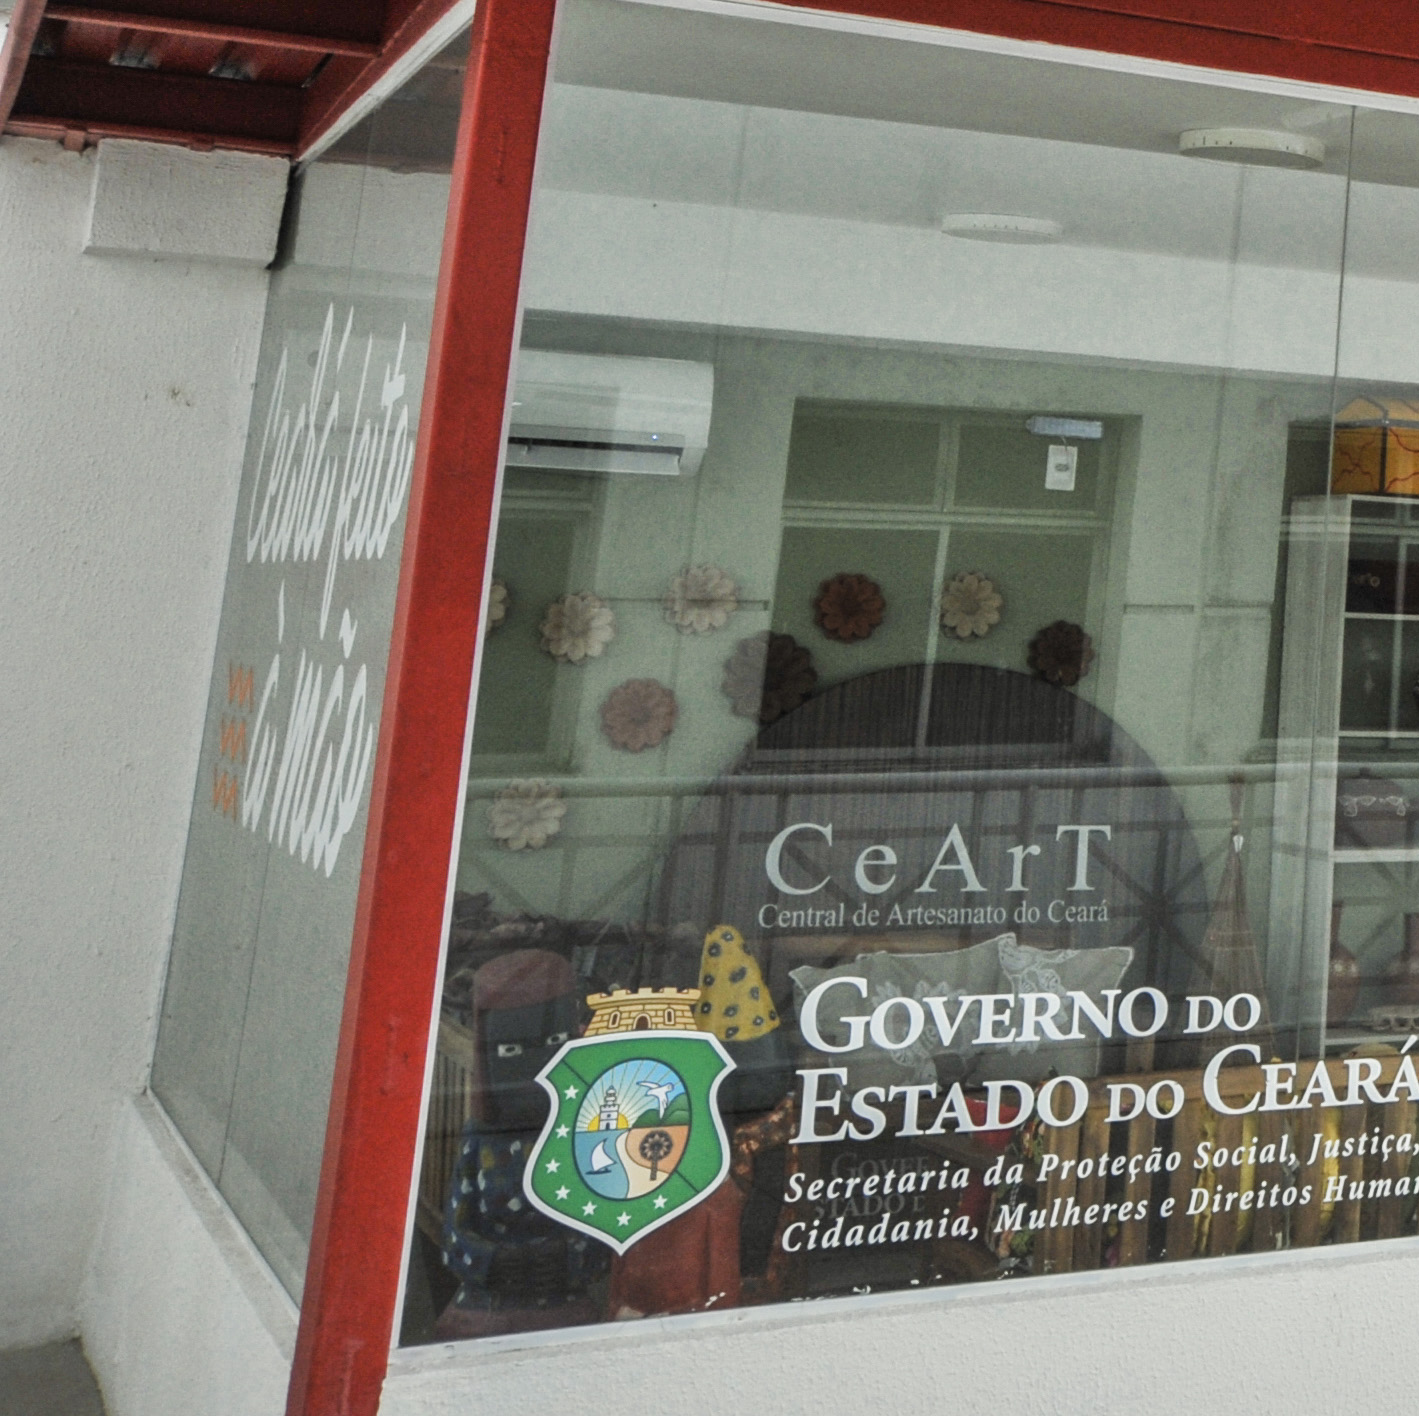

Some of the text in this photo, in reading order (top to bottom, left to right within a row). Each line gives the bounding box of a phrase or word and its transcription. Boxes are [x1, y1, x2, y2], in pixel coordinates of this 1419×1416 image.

[765, 823, 1112, 896] CeArT
[758, 899, 1110, 928] Central de Artesanato do Ceará
[800, 976, 1261, 1053] GOVERNO DO
[789, 1067, 1089, 1144] ESTADO
[1104, 1079, 1185, 1123] DO
[784, 1127, 1419, 1203] Secretaria da Proteção Social, Justiça,
[782, 1209, 978, 1252] Cidadania,
[994, 1197, 1148, 1233] Mulheres
[1161, 1196, 1175, 1217] e
[1187, 1182, 1312, 1216] Direitos
